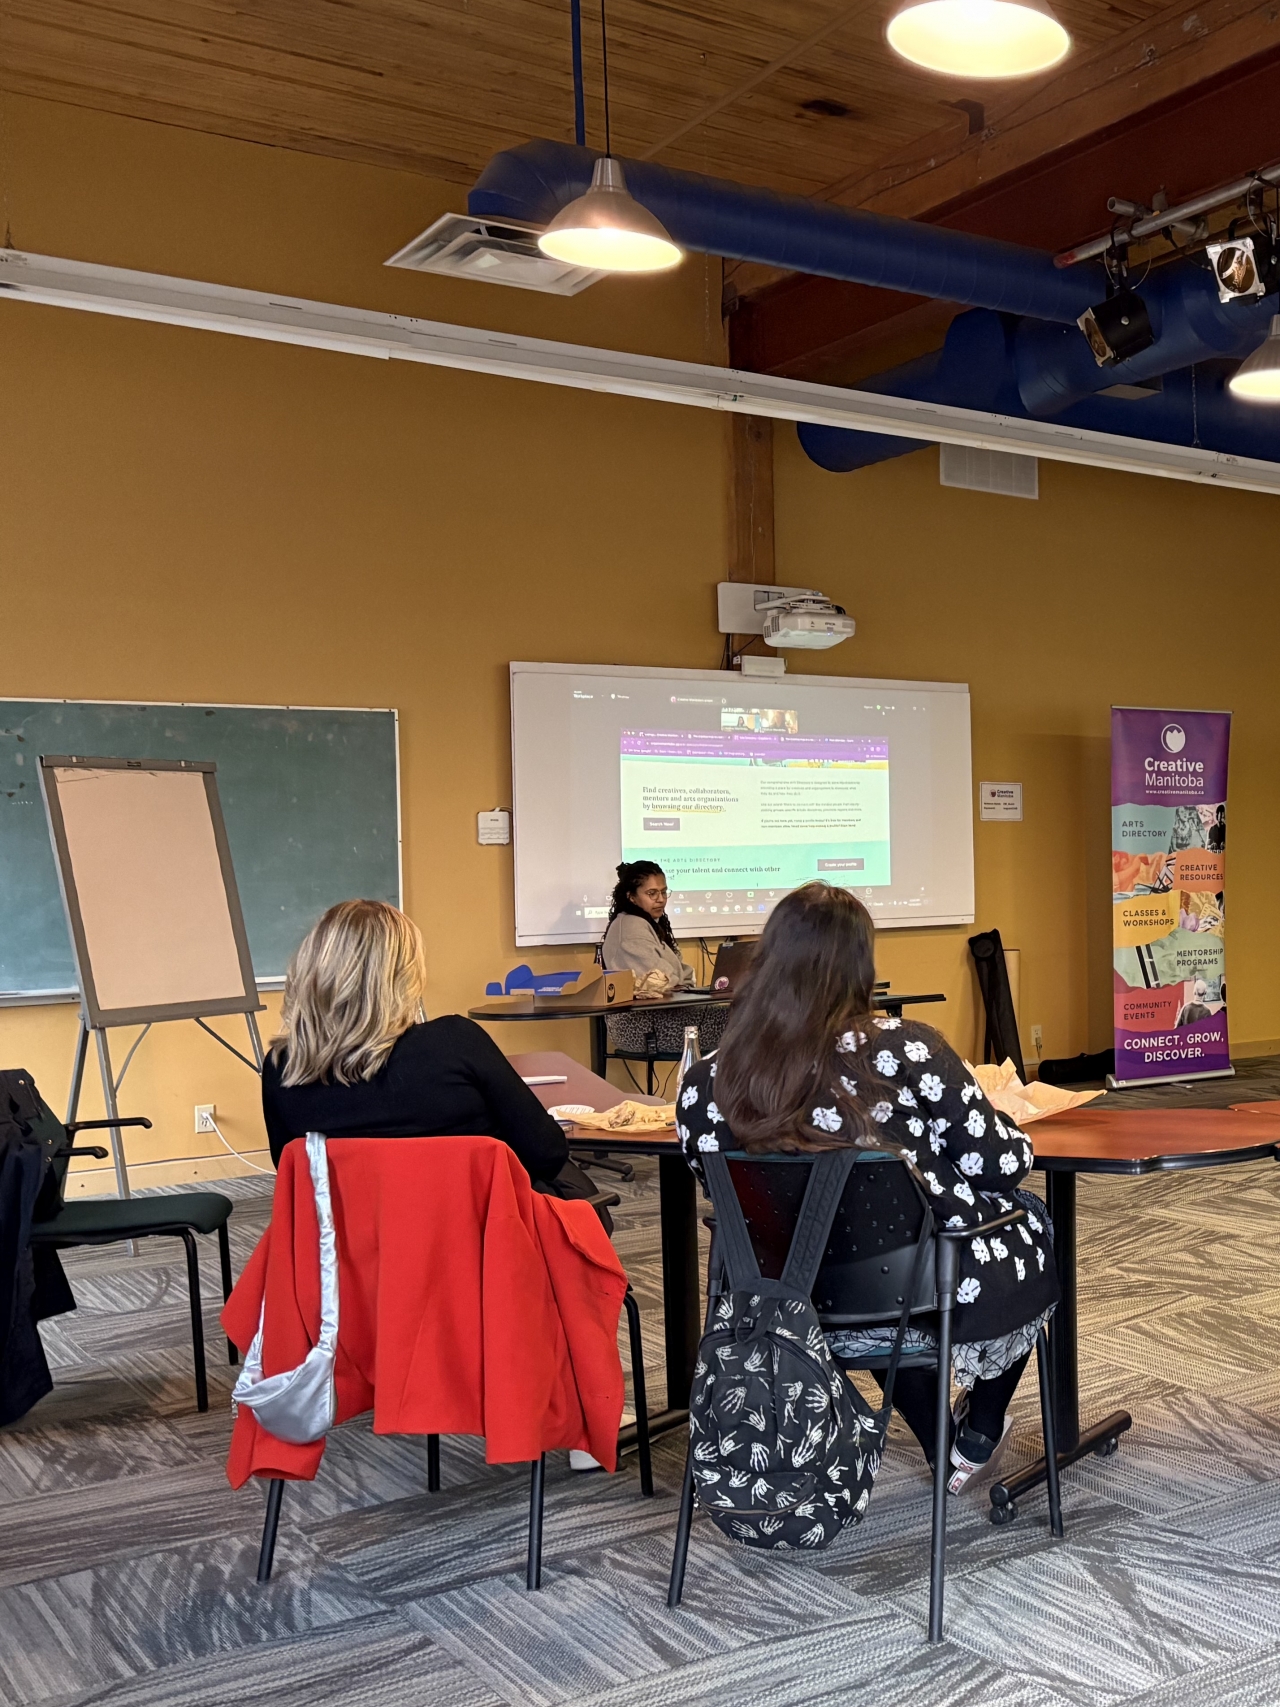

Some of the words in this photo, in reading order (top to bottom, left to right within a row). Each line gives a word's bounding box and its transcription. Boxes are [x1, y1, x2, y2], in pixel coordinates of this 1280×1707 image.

[1144, 757, 1204, 772] Creative
[1146, 773, 1204, 786] Manitoba
[1176, 948, 1224, 957] MENTORSHIP
[1124, 1001, 1172, 1010] COMMUNITY
[1124, 1012, 1155, 1020] EVENTS
[1124, 1035, 1183, 1050] CONNECT,
[1187, 1032, 1224, 1044] GROW,
[1144, 1048, 1204, 1063] DISCOVER.
